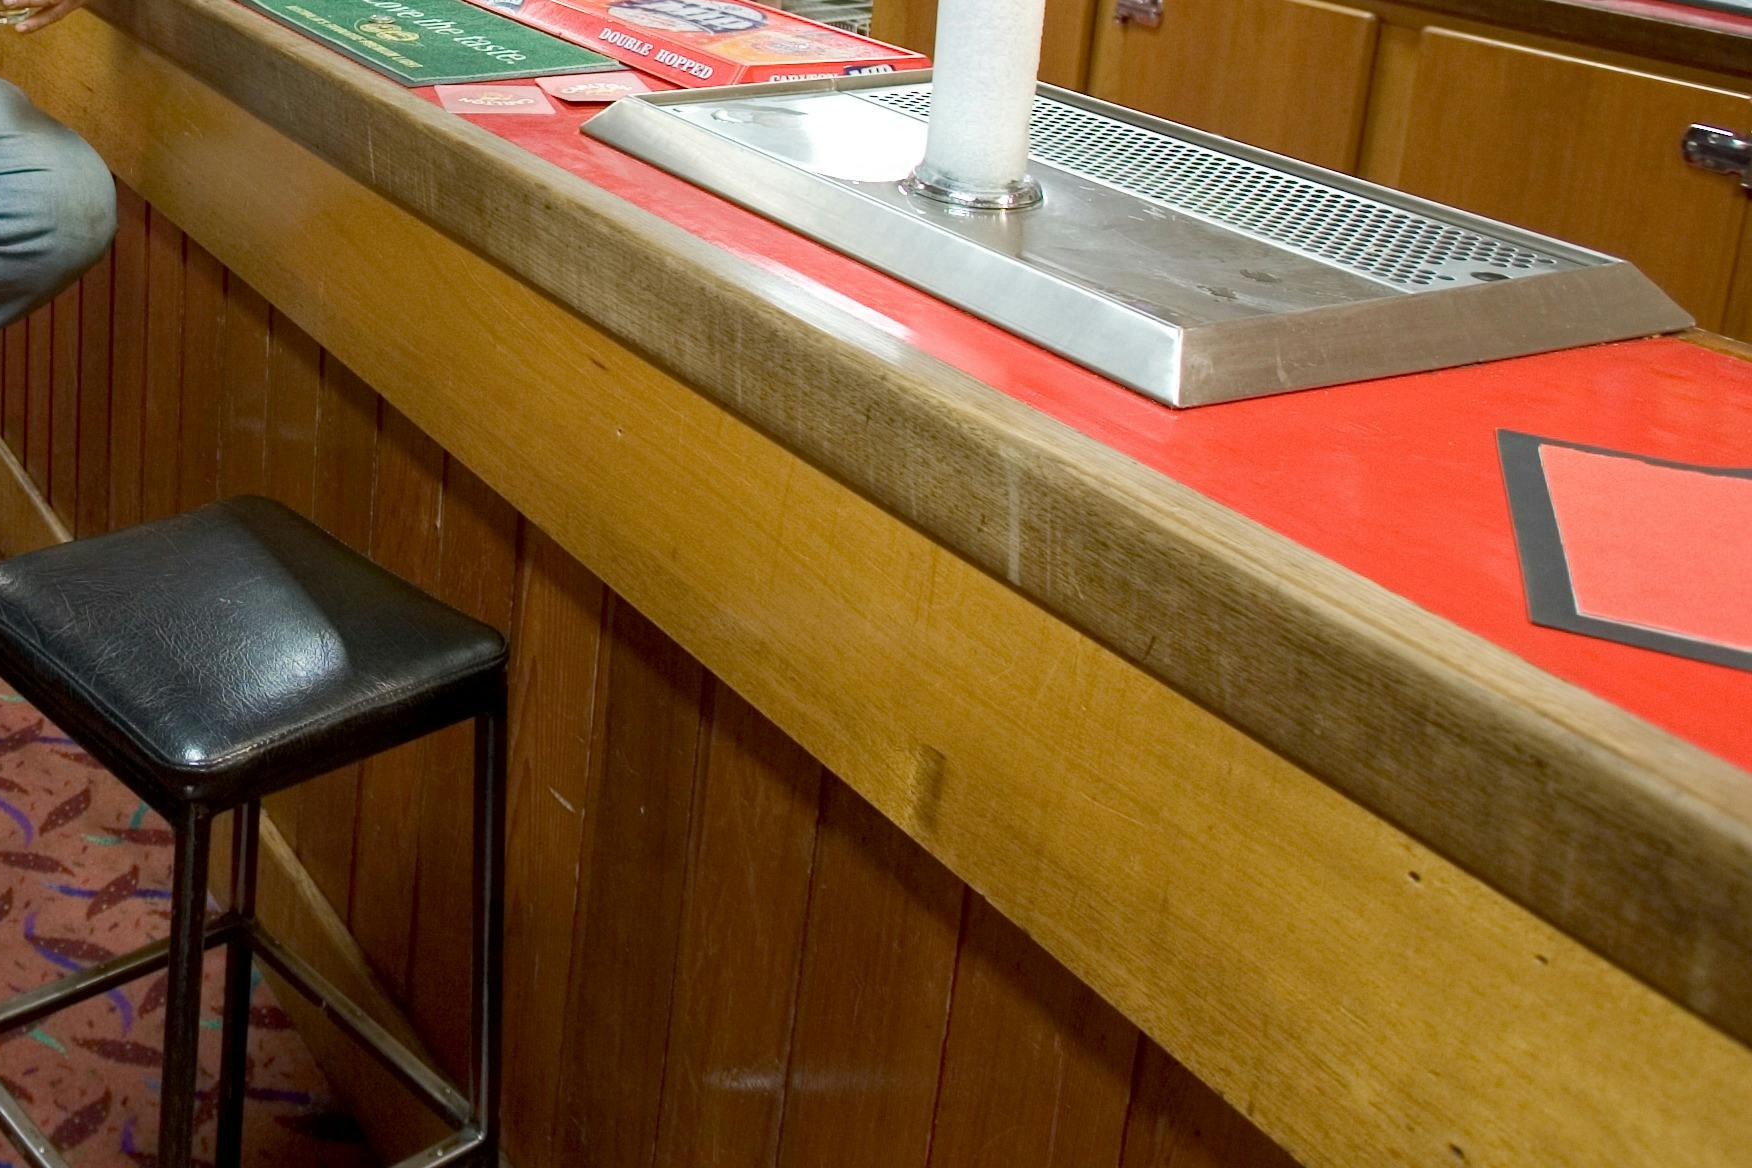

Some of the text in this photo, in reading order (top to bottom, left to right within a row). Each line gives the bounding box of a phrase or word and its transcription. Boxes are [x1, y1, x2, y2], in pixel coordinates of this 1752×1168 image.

[413, 17, 464, 35] the
[453, 35, 526, 65] taste.
[598, 28, 714, 80] DOUBLE HOPPED
